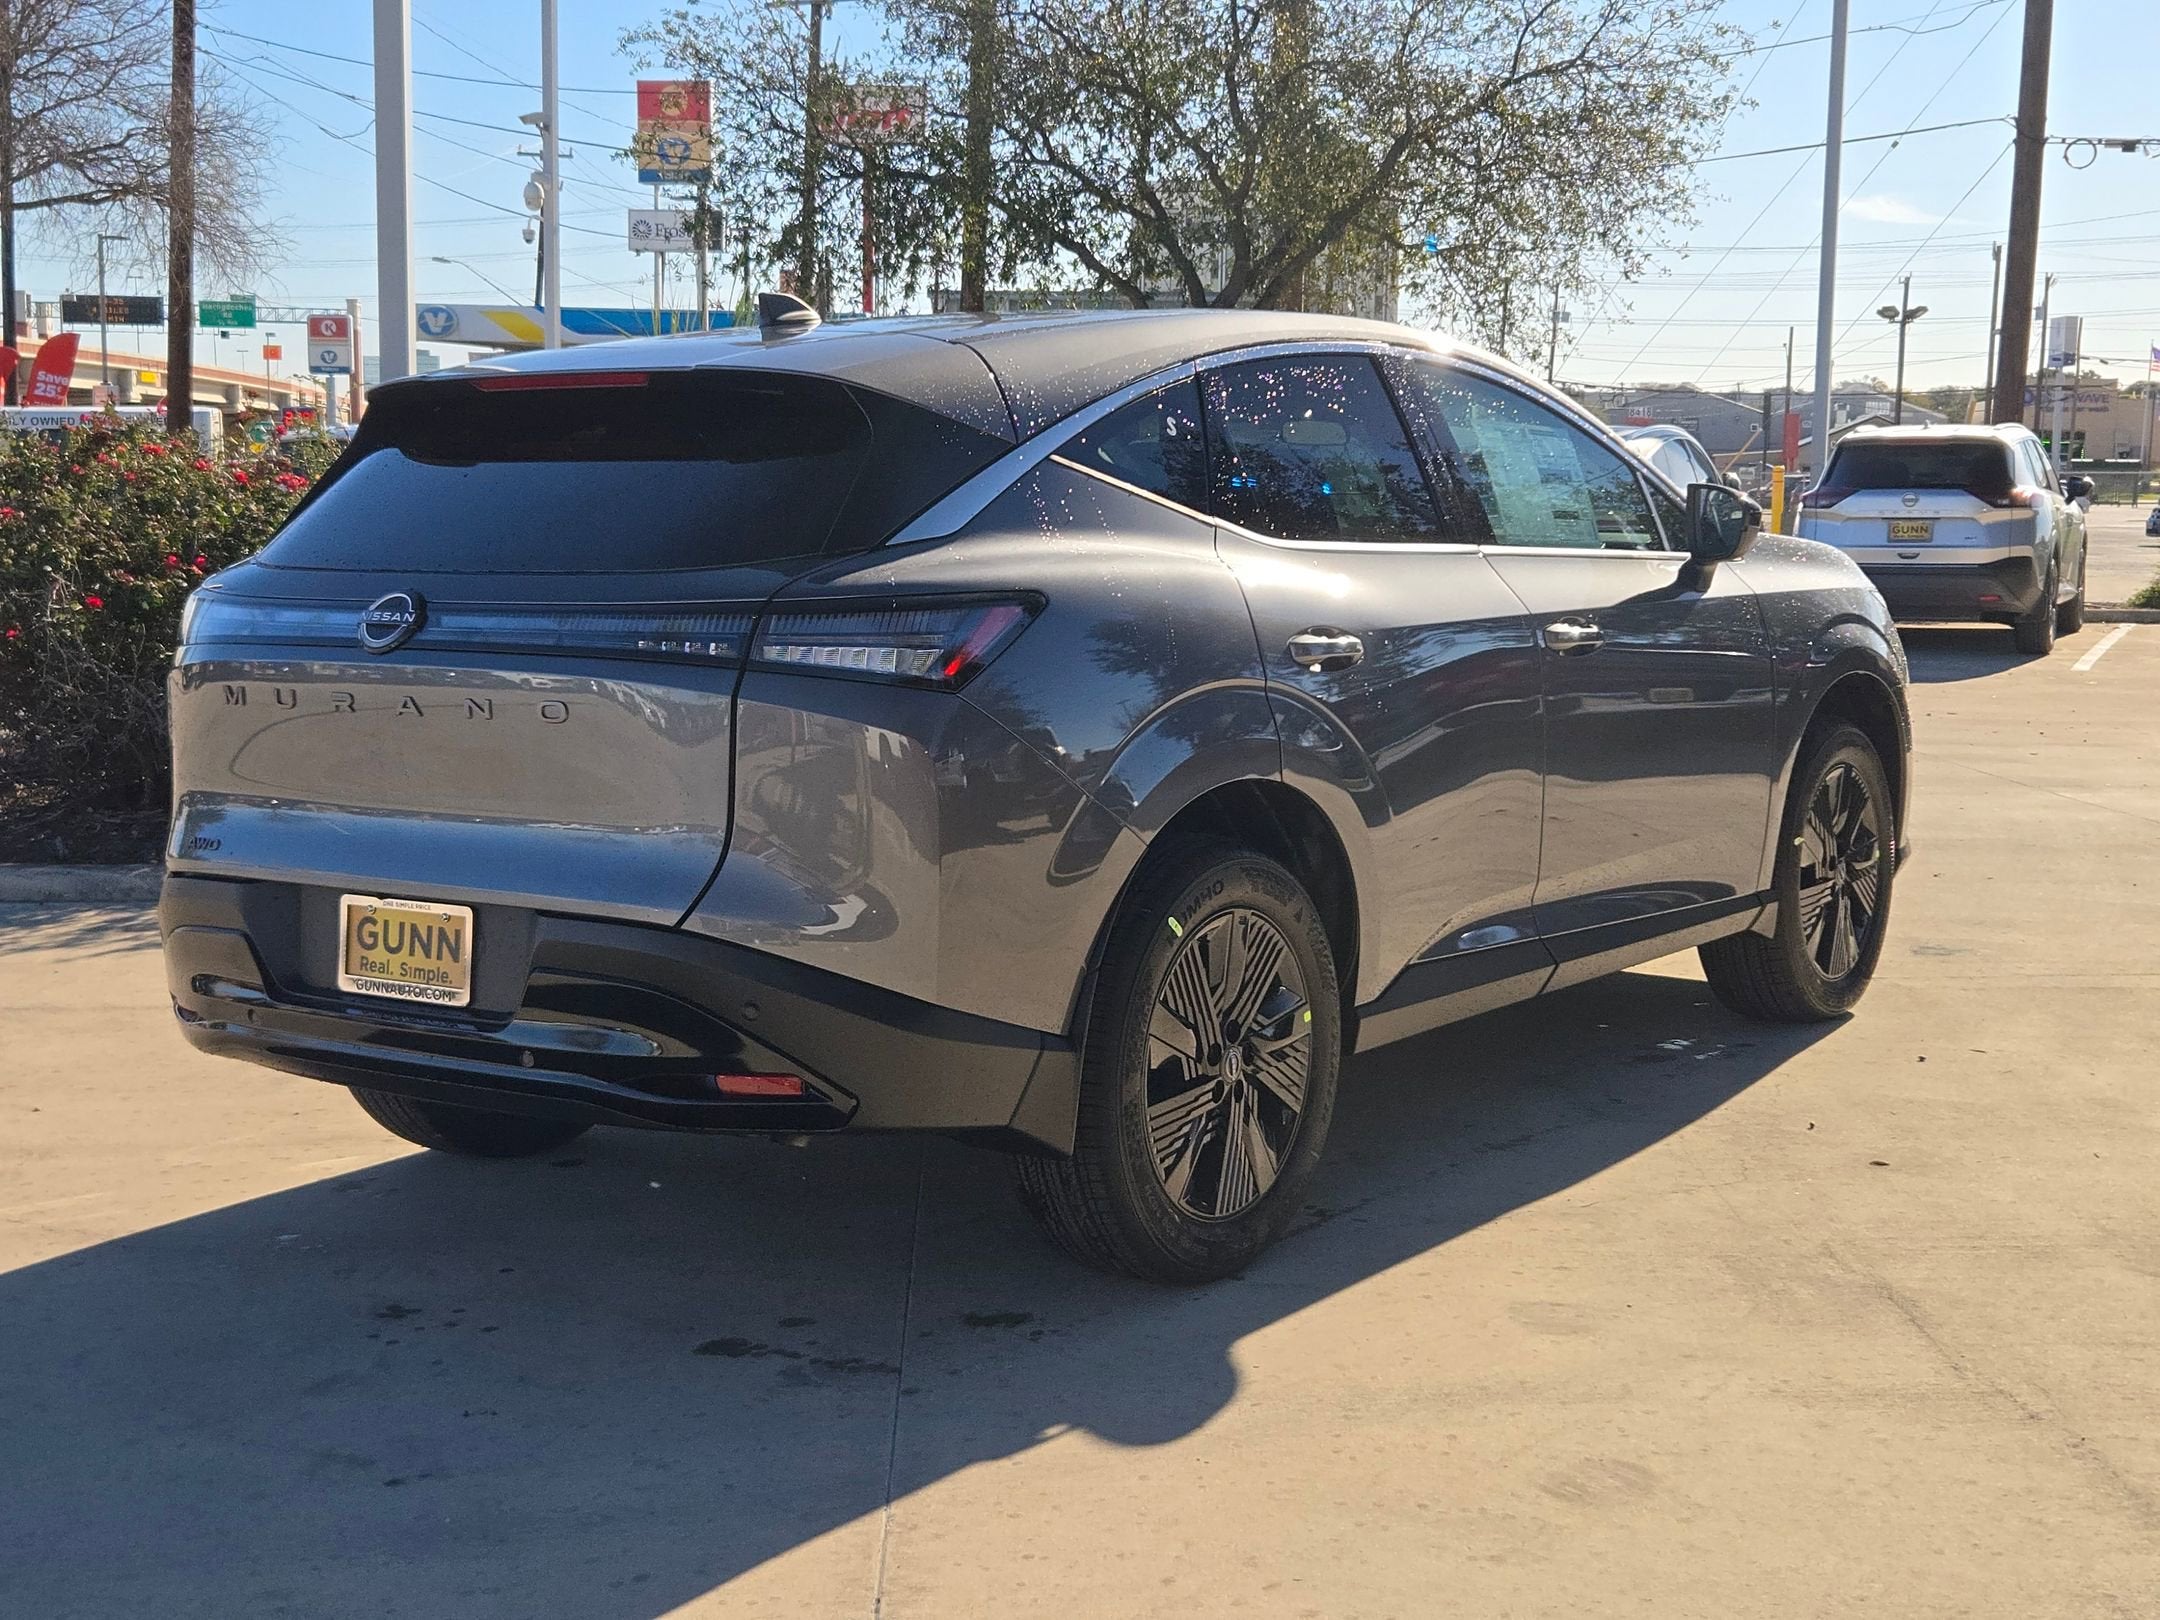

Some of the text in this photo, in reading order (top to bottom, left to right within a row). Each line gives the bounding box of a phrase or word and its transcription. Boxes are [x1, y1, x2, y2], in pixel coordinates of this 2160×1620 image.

[37, 371, 69, 385] Save
[30, 416, 75, 426] OWNED
[1892, 525, 1929, 535] GUNN
[361, 611, 416, 622] NISSAN
[223, 684, 570, 725] MURANO
[189, 836, 222, 851] AWD
[356, 915, 462, 963] GUNN
[360, 955, 453, 985] Real. Simple.
[355, 979, 453, 1003] GUNNAUTO.COM
